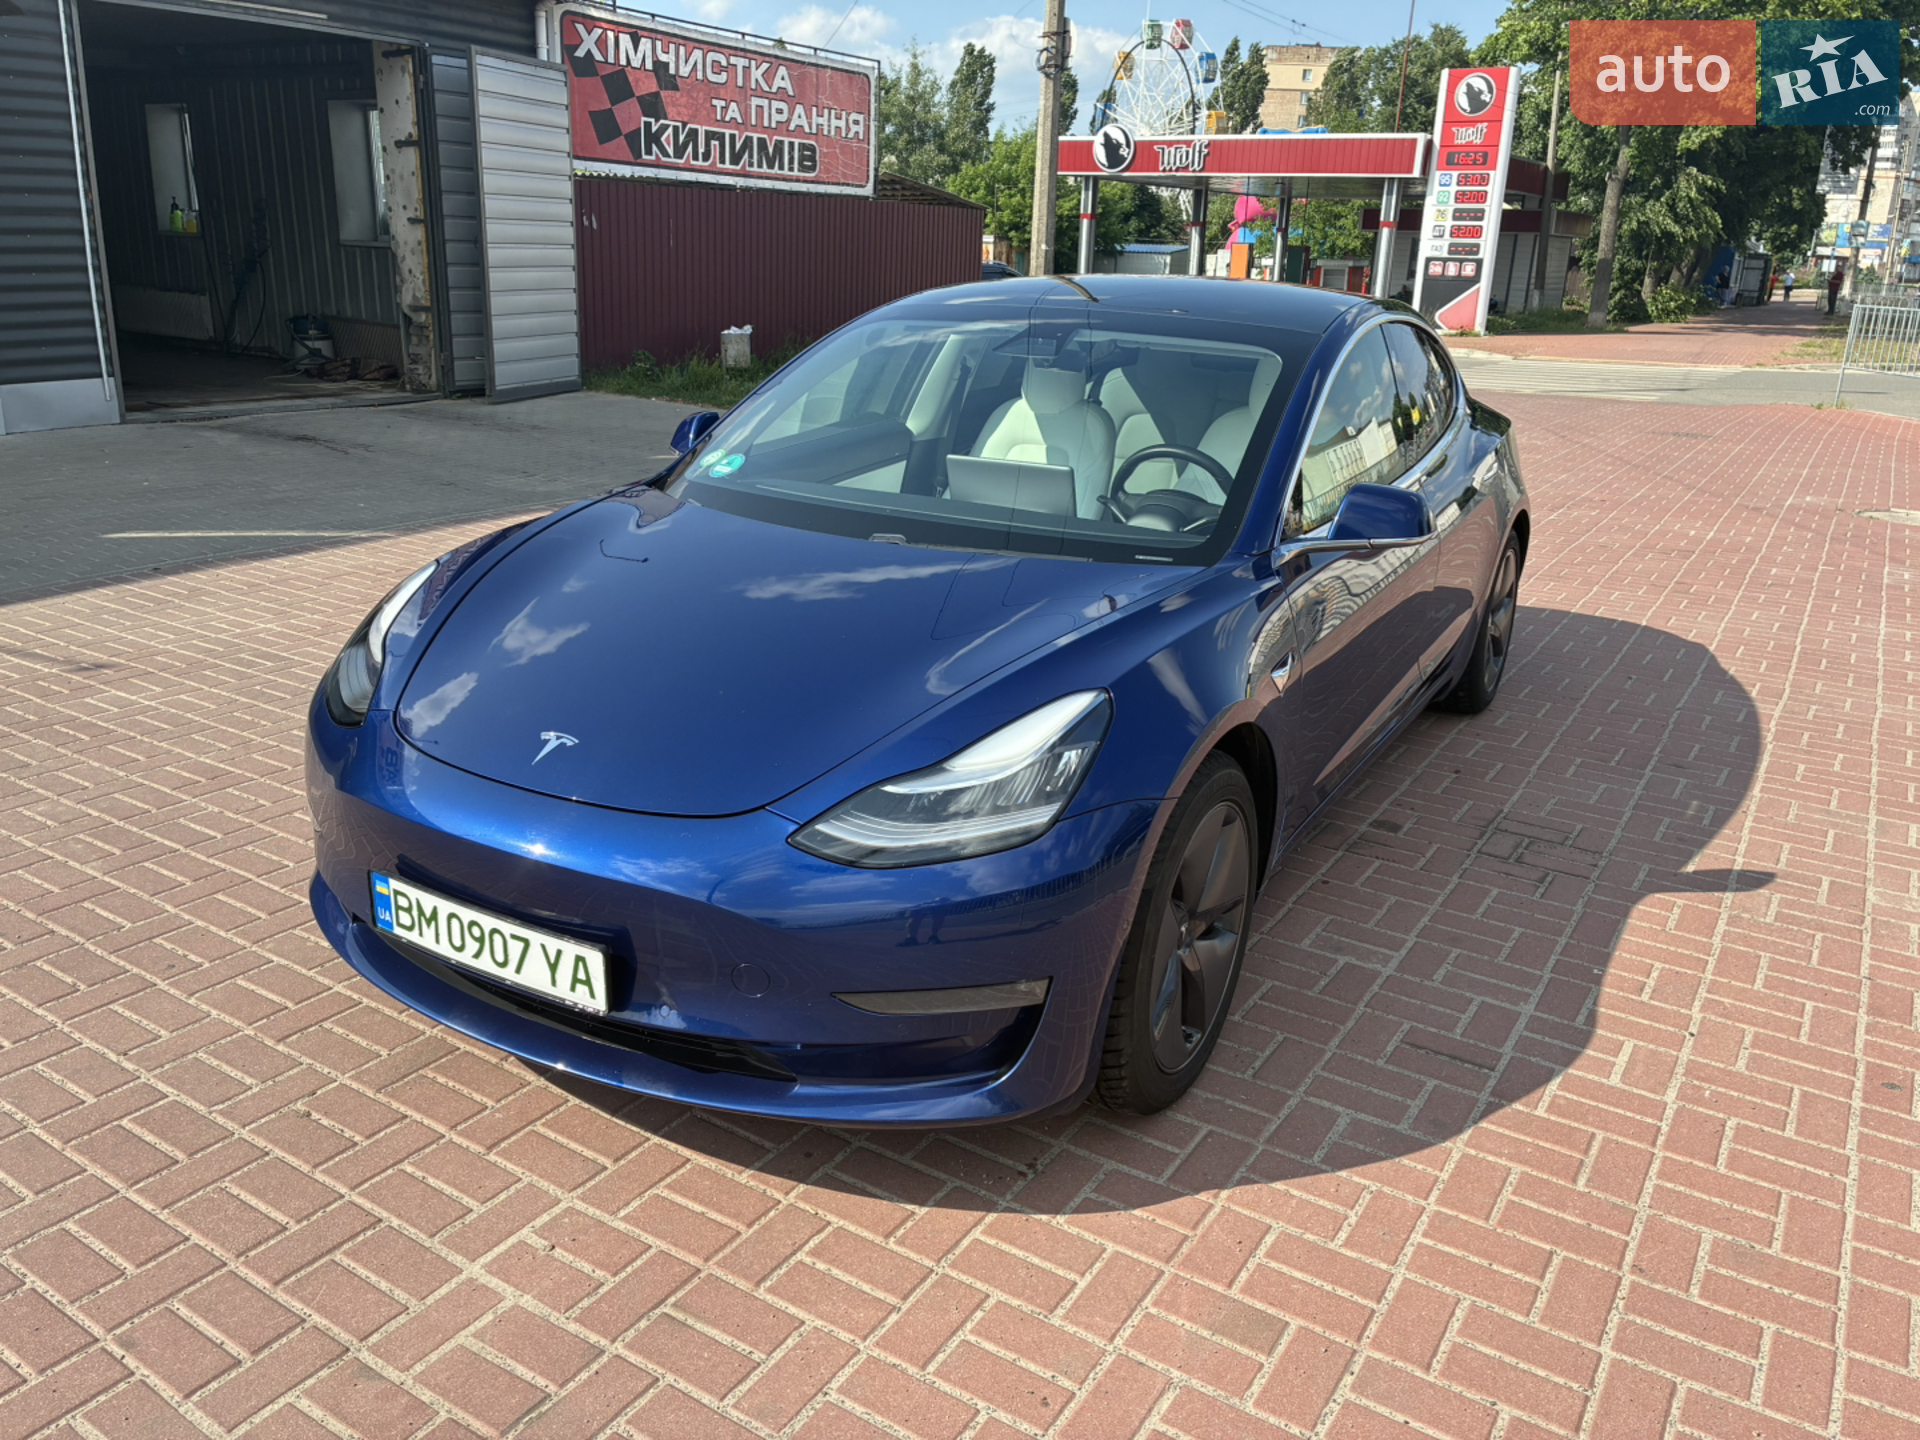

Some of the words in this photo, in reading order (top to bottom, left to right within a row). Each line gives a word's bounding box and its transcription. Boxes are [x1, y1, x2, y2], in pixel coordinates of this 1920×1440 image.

[572, 21, 795, 96] ХІМЧИСТКА
[711, 98, 744, 125] ТА
[750, 96, 866, 140] ПРАННЯ
[1451, 122, 1488, 145] Wolf
[641, 117, 819, 176] КИЛИМІВ
[1153, 139, 1209, 172] Wolf
[377, 906, 392, 923] UA
[393, 888, 440, 945] BM
[446, 912, 530, 975] 0907
[540, 943, 596, 1000] YA
